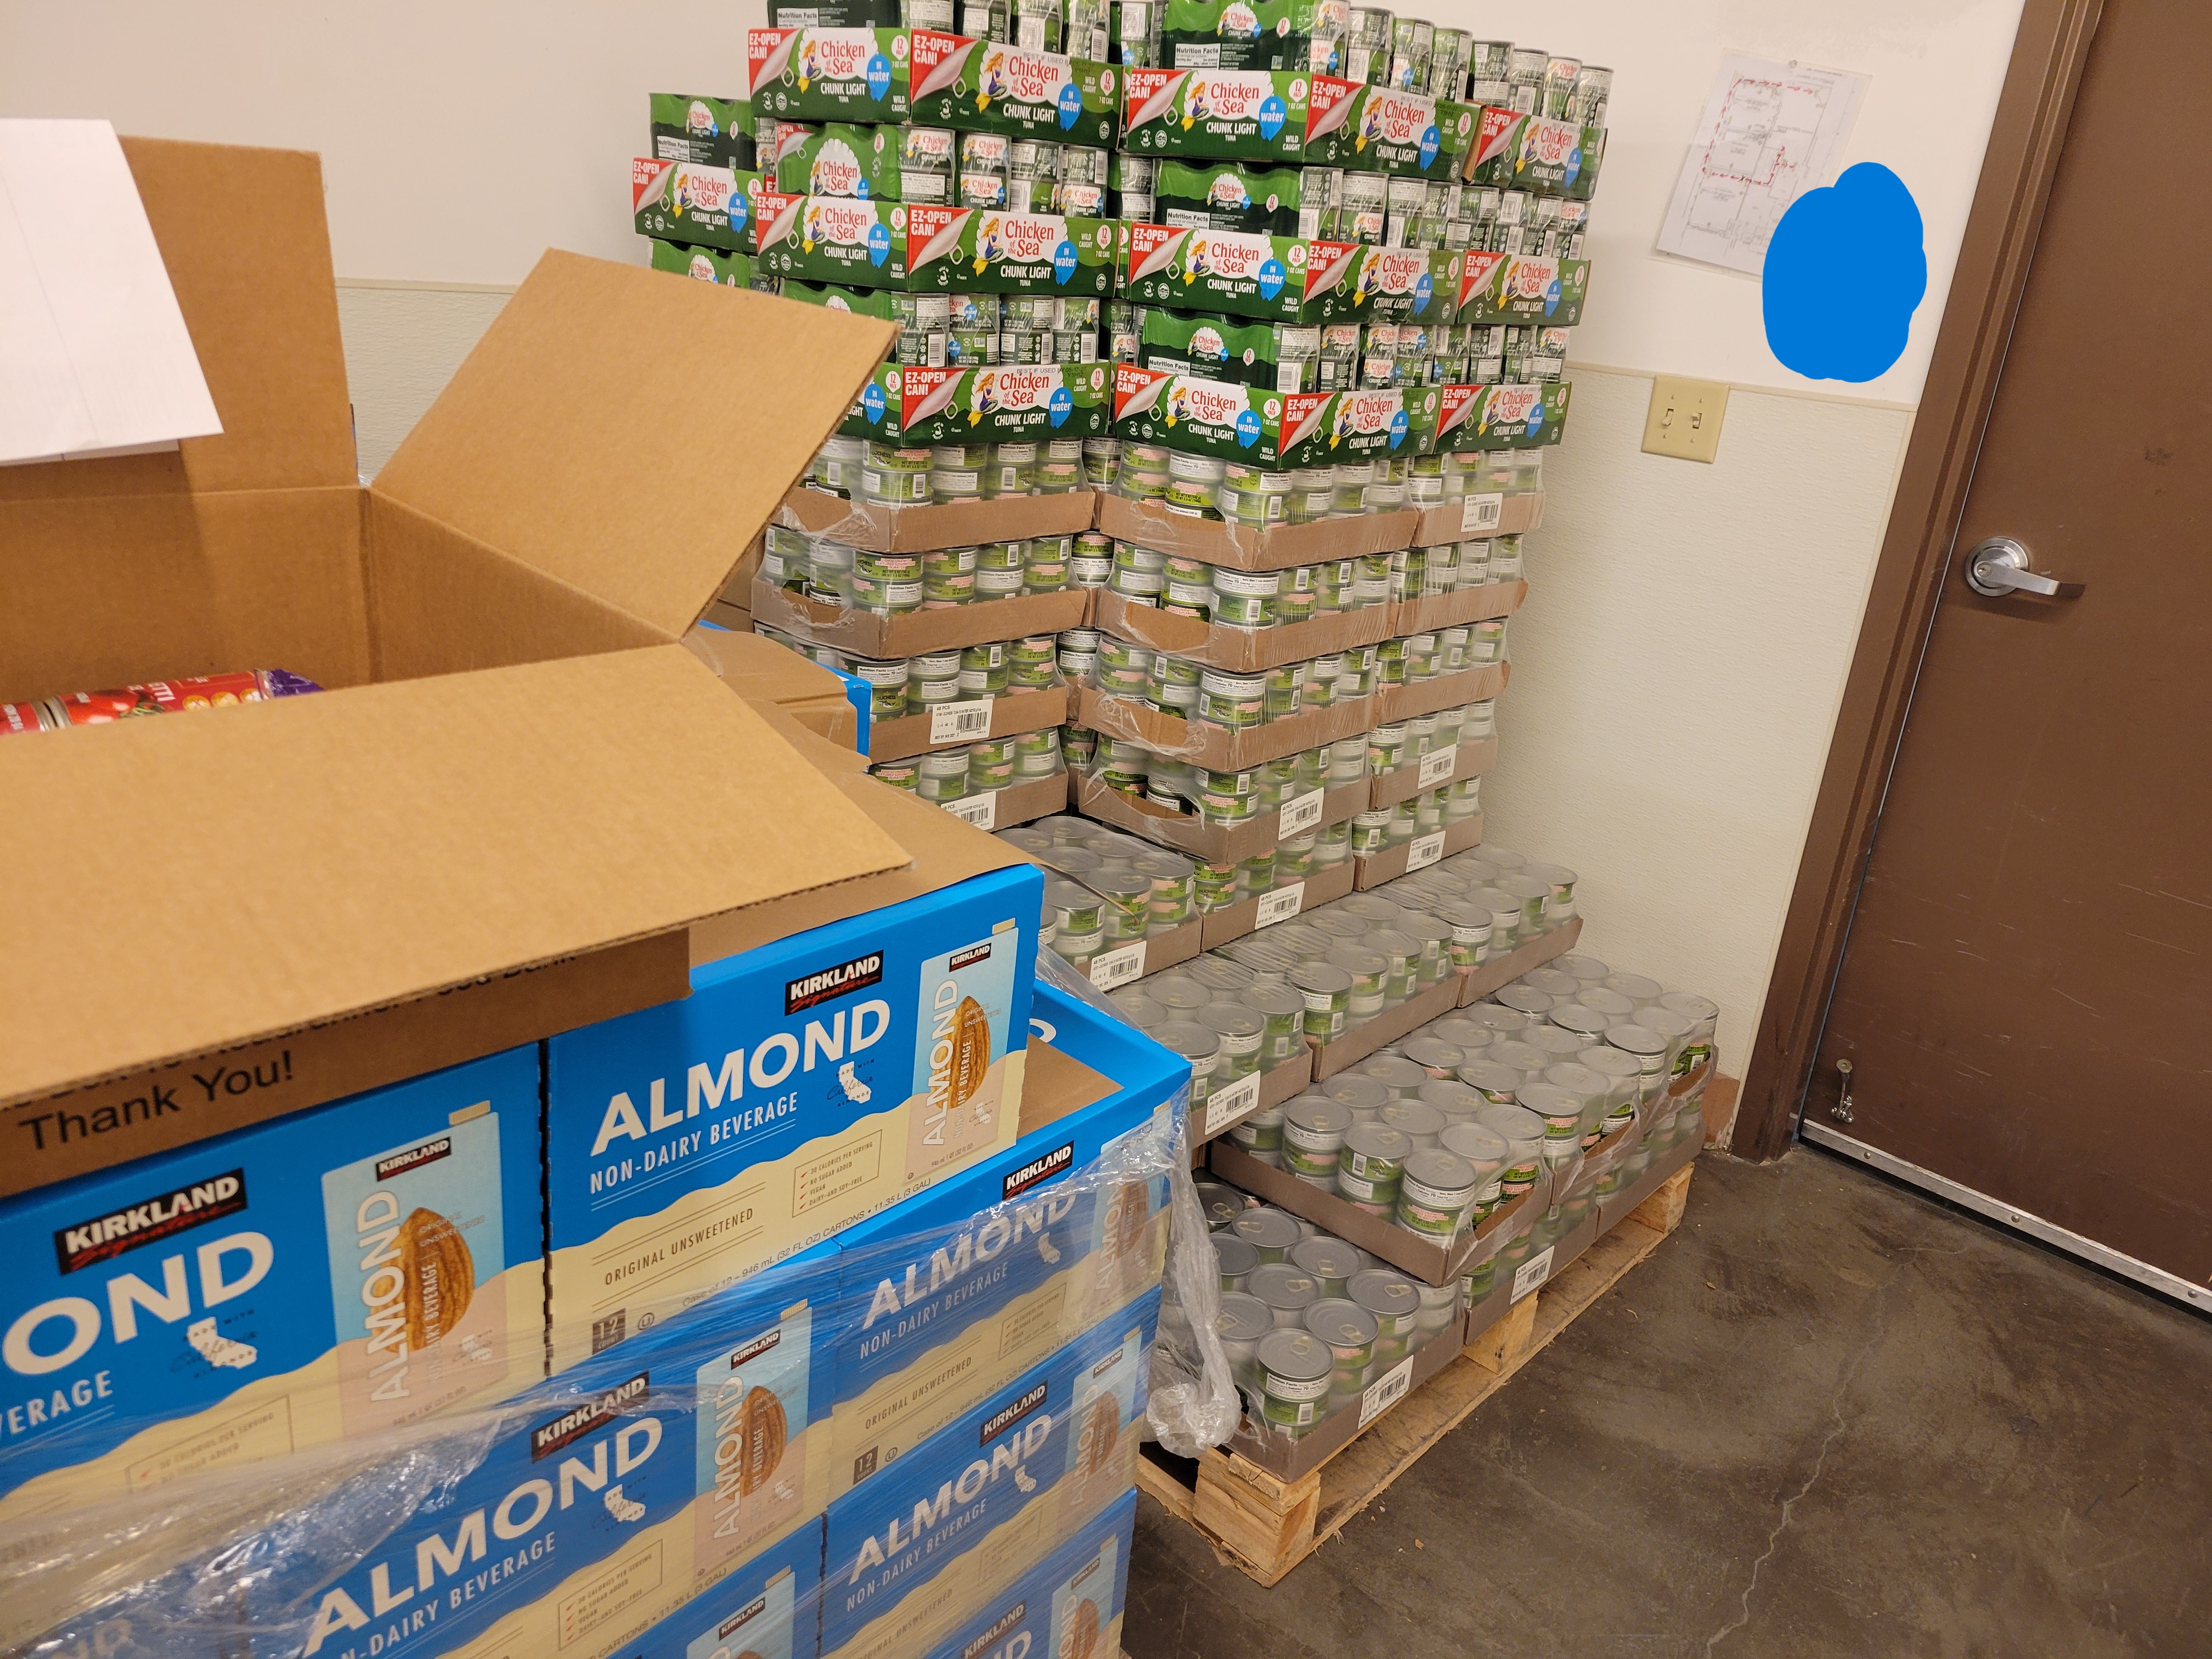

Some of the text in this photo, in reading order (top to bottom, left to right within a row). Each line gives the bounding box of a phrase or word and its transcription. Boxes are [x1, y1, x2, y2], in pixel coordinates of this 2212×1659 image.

[749, 33, 781, 46] EZ-OPEN
[749, 46, 767, 59] CAN!
[821, 40, 865, 60] Chicken
[833, 58, 854, 74] Sea
[868, 71, 890, 82] water
[1131, 74, 1167, 86] EZ-OPEN
[821, 82, 866, 95] CHUNK LIGHT
[1211, 83, 1259, 100] Chicken
[1222, 99, 1244, 115] Sea
[1206, 122, 1256, 135] CHUNK LIGHT
[634, 161, 659, 173] EZ-OPEN
[692, 176, 727, 195] Chicken
[1218, 183, 1242, 193] Chicken
[911, 210, 951, 222] EZ-OPEN
[911, 222, 934, 236] CAN!
[1005, 220, 1054, 244] Chicken
[1133, 228, 1169, 241] EZ-OPEN
[1017, 239, 1040, 256] Sea
[1133, 240, 1152, 252] CAN!
[1212, 242, 1259, 262] Chicken
[1294, 247, 1300, 257] 12
[1001, 265, 1051, 279] CHUNK LIGHT
[1222, 258, 1244, 274] Sea
[1383, 255, 1419, 275] Chicken
[1521, 263, 1551, 280] Chicken
[1207, 279, 1256, 295] CHUNK LIGHT
[1261, 274, 1284, 285] water
[1282, 304, 1299, 313] CAUGHT
[1285, 297, 1297, 306] WILD
[1513, 300, 1543, 312] CHUNK LIGHT
[1149, 360, 1173, 368] Nutrition
[905, 371, 946, 383] EZ-OPEN
[1000, 372, 1049, 392] Chicken
[905, 383, 929, 396] CAN!
[1011, 390, 1034, 407] Sea
[1191, 390, 1237, 411] Chicken
[1288, 399, 1318, 410] EZ-OPEN
[1356, 397, 1392, 414] Chicken
[995, 413, 1046, 426] CHUNK LIGHT
[1202, 406, 1223, 421] Sea
[1188, 423, 1235, 440] CHUNK LIGHT
[1348, 435, 1387, 449] CHUNK LIGHT
[1211, 704, 1232, 712] DUCHESS
[951, 945, 990, 966] KIRKLAND
[790, 955, 880, 1000] KIRKLAND
[792, 975, 879, 1011] Signature
[857, 1058, 874, 1069] WITH
[923, 979, 958, 1146] ALMOND
[960, 1040, 972, 1087] BEVERAGE
[590, 998, 891, 1157] ALMOND
[18, 1083, 180, 1152] Thank
[193, 1050, 294, 1103] You!
[590, 1091, 798, 1195] NON-DAIRY BEVERAGE
[377, 1138, 450, 1174] KIRKLAND
[819, 1155, 842, 1170] CALORIES
[843, 1151, 852, 1160] PER
[853, 1142, 873, 1155] SERVING
[819, 1169, 834, 1181] SUGAR
[836, 1161, 853, 1173] ADDED
[1006, 1145, 1073, 1190] KIRKLAND
[810, 1183, 826, 1195] VEGAN
[64, 1175, 240, 1255] KIRKLAND
[742, 1262, 759, 1277] 946
[760, 1255, 775, 1269] mL
[777, 1246, 791, 1262] (32
[793, 1240, 804, 1252] FL
[806, 1232, 821, 1246] OZ)
[823, 1210, 865, 1238] CARTONS
[874, 1197, 895, 1212] 11.35
[904, 1187, 912, 1200] (3
[913, 1177, 931, 1195] GAL)
[605, 1207, 753, 1285] ORIGINAL UNSWEETENED
[862, 1195, 1077, 1329] ALMOND
[357, 1189, 411, 1403] ALMOND
[420, 1261, 439, 1322] BEVERAGE
[860, 1263, 1008, 1359] NON-DAIRY BEVERAGE
[598, 1316, 619, 1340] 12
[732, 1332, 780, 1363] KIRKLAND
[1094, 1349, 1122, 1375] KIRKLAND
[865, 1356, 972, 1430] ORIGINAL UNSWEETENED
[538, 1376, 648, 1447] KIRKLAND
[983, 1384, 1046, 1436] KIRKLAND
[714, 1376, 744, 1539] ALMOND
[857, 1452, 873, 1472] 12
[848, 1413, 1053, 1585] ALMOND
[303, 1417, 663, 1656] ALMOND
[847, 1498, 988, 1612] NON-DAIRY BEVERAGE
[449, 1531, 557, 1609] BEVERAGE
[721, 1599, 764, 1634] KIRKLAND
[964, 1602, 1025, 1656] KIRKLAND
